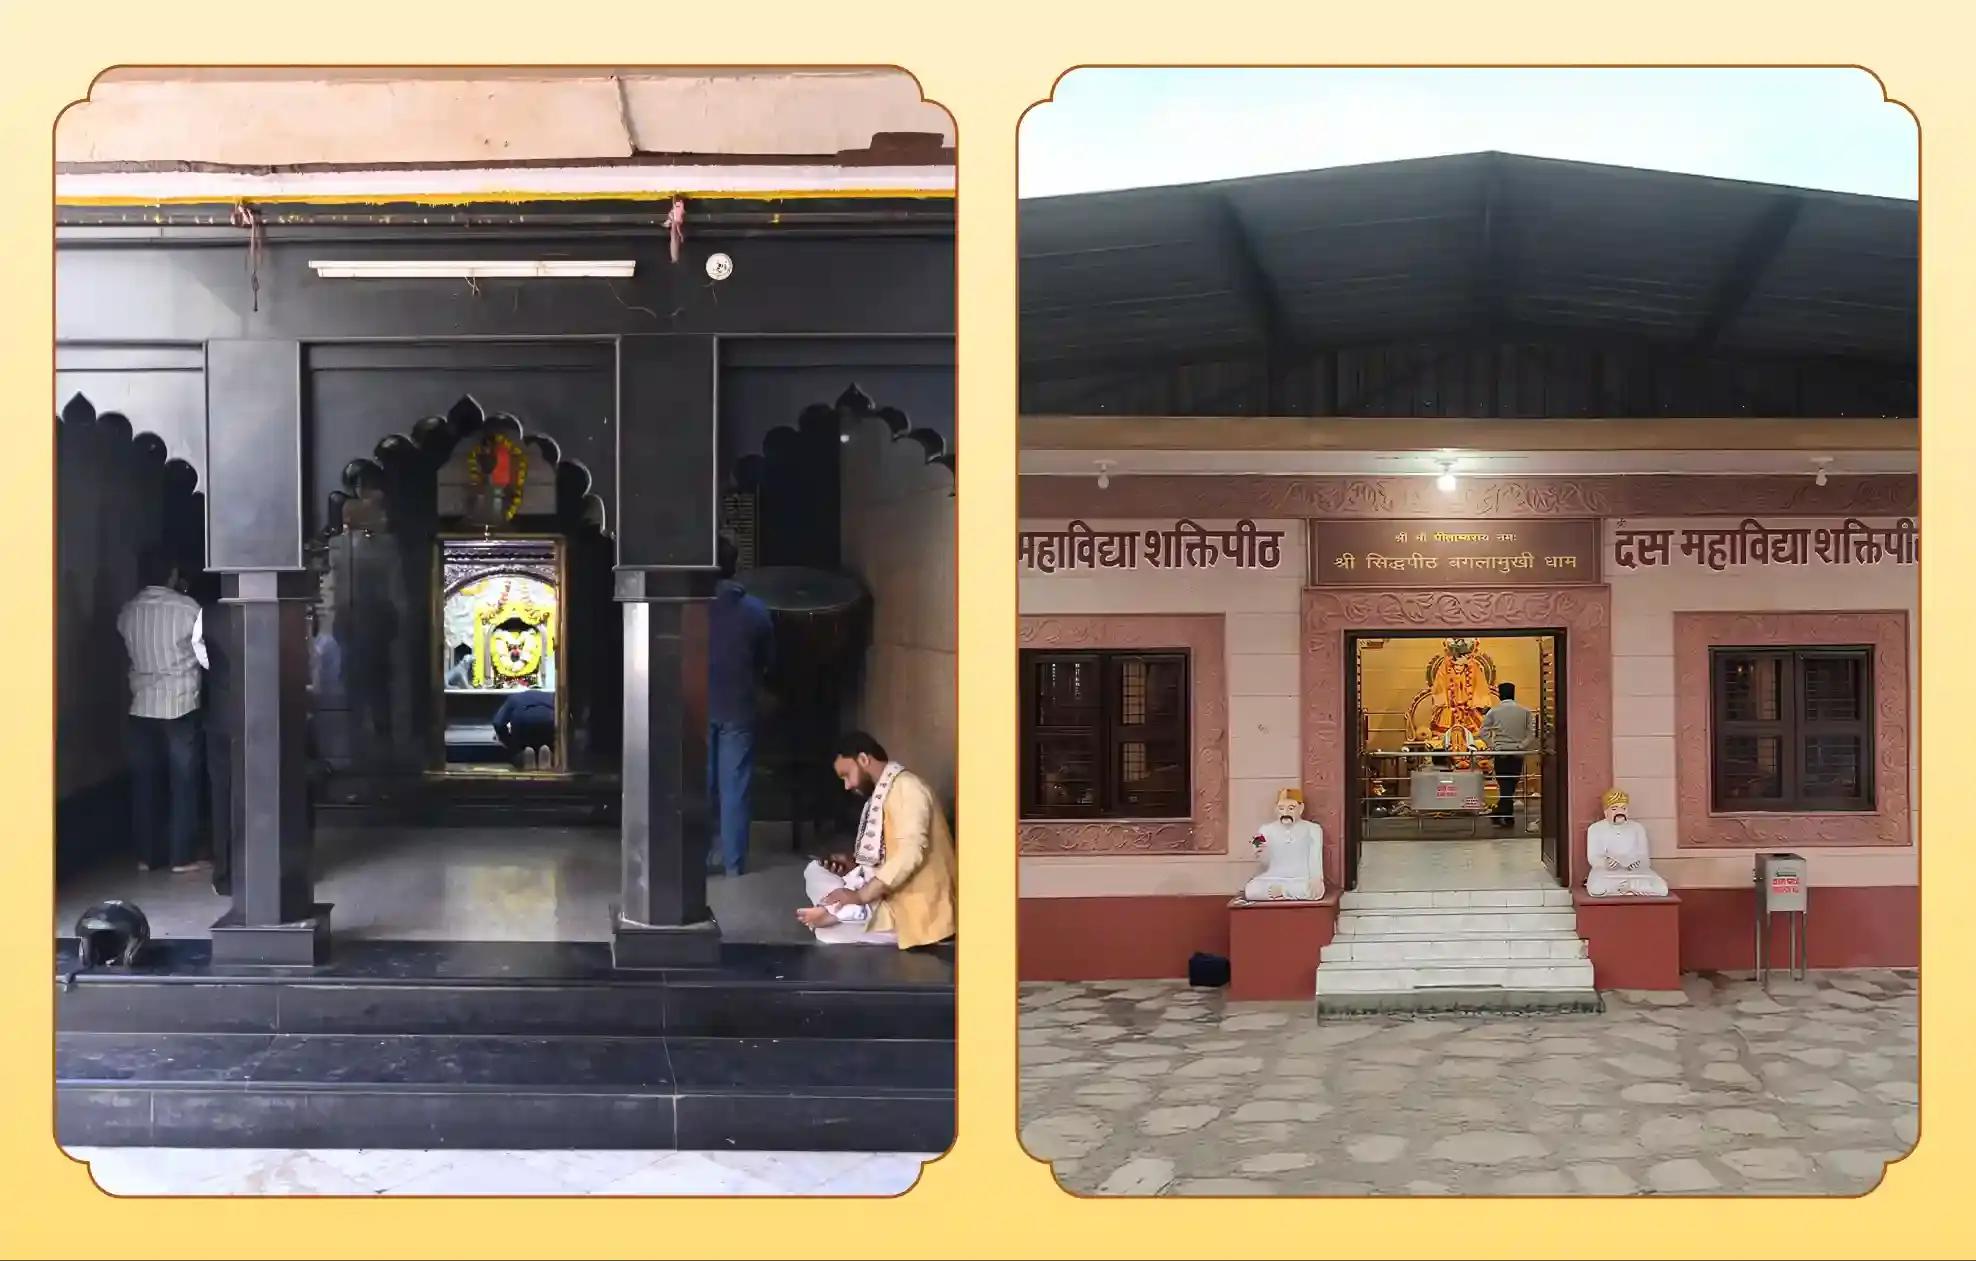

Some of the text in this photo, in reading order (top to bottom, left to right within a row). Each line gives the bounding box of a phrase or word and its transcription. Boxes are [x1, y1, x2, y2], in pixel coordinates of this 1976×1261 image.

[1144, 518, 1285, 568] शक्तिपीठ
[1333, 552, 1355, 570] श्री
[1366, 552, 1439, 572] सिद्धपीठ
[1544, 555, 1577, 569] धाम
[1615, 518, 1919, 571] दस महाविद्या शक्तिपी
